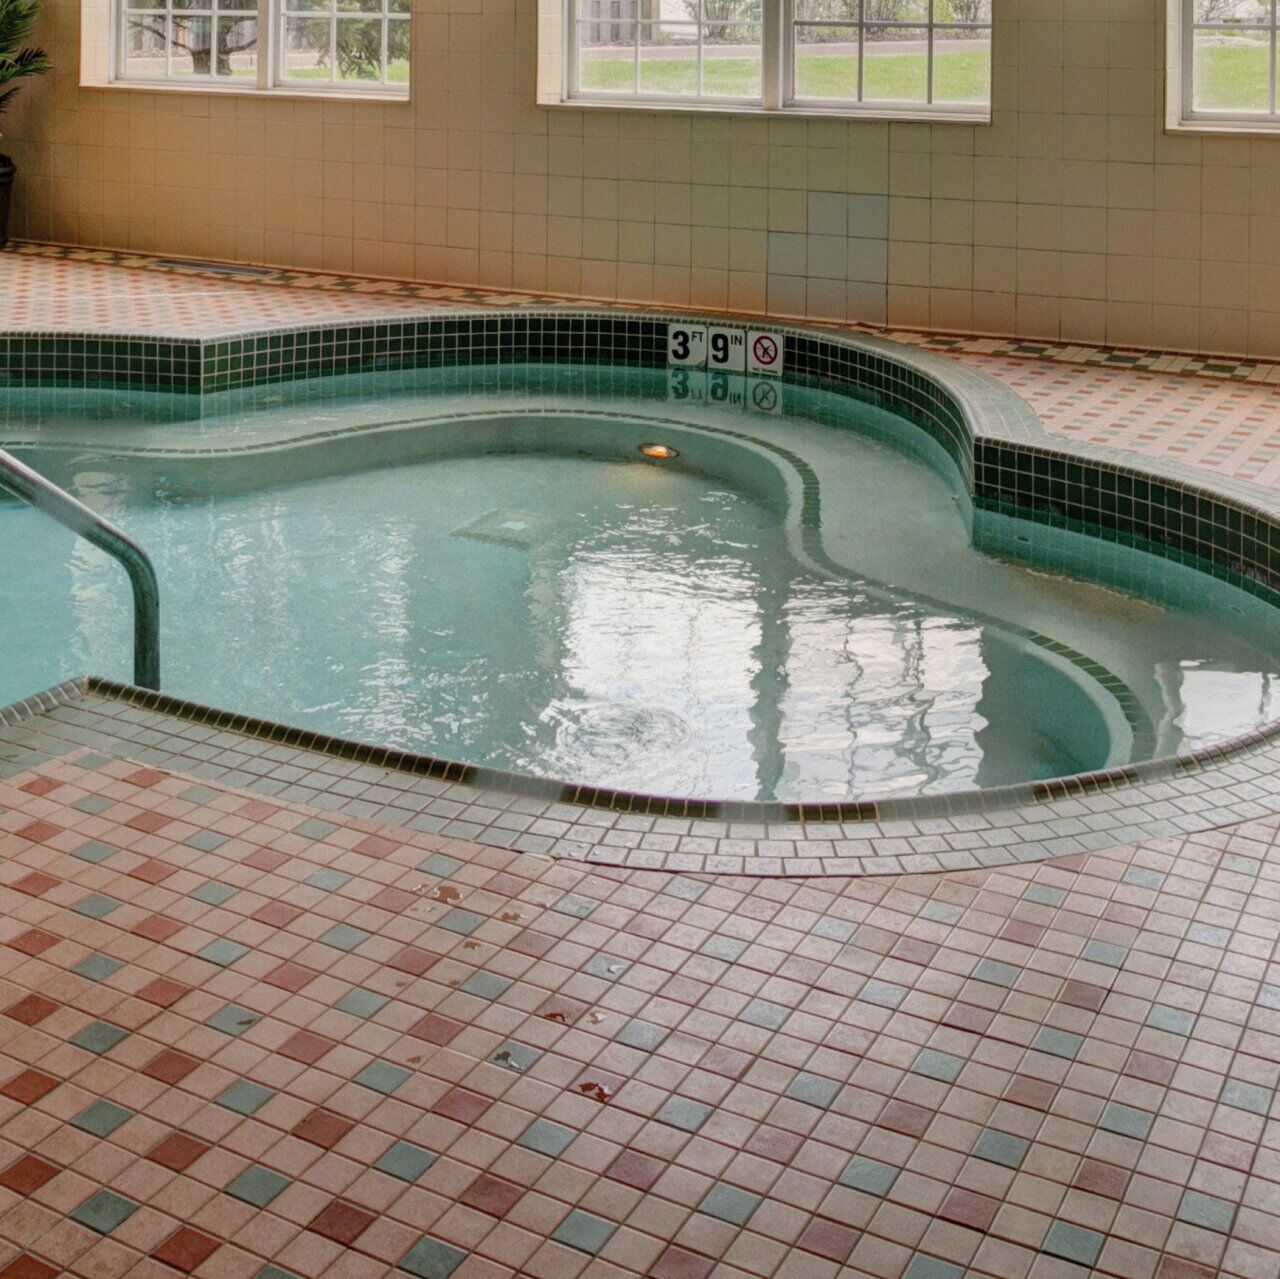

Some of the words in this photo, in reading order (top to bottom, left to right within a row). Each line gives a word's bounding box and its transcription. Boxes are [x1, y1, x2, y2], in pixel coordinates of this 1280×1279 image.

[671, 330, 691, 360] 3
[691, 331, 704, 343] FT
[711, 333, 729, 364] 9
[730, 335, 743, 346] IN
